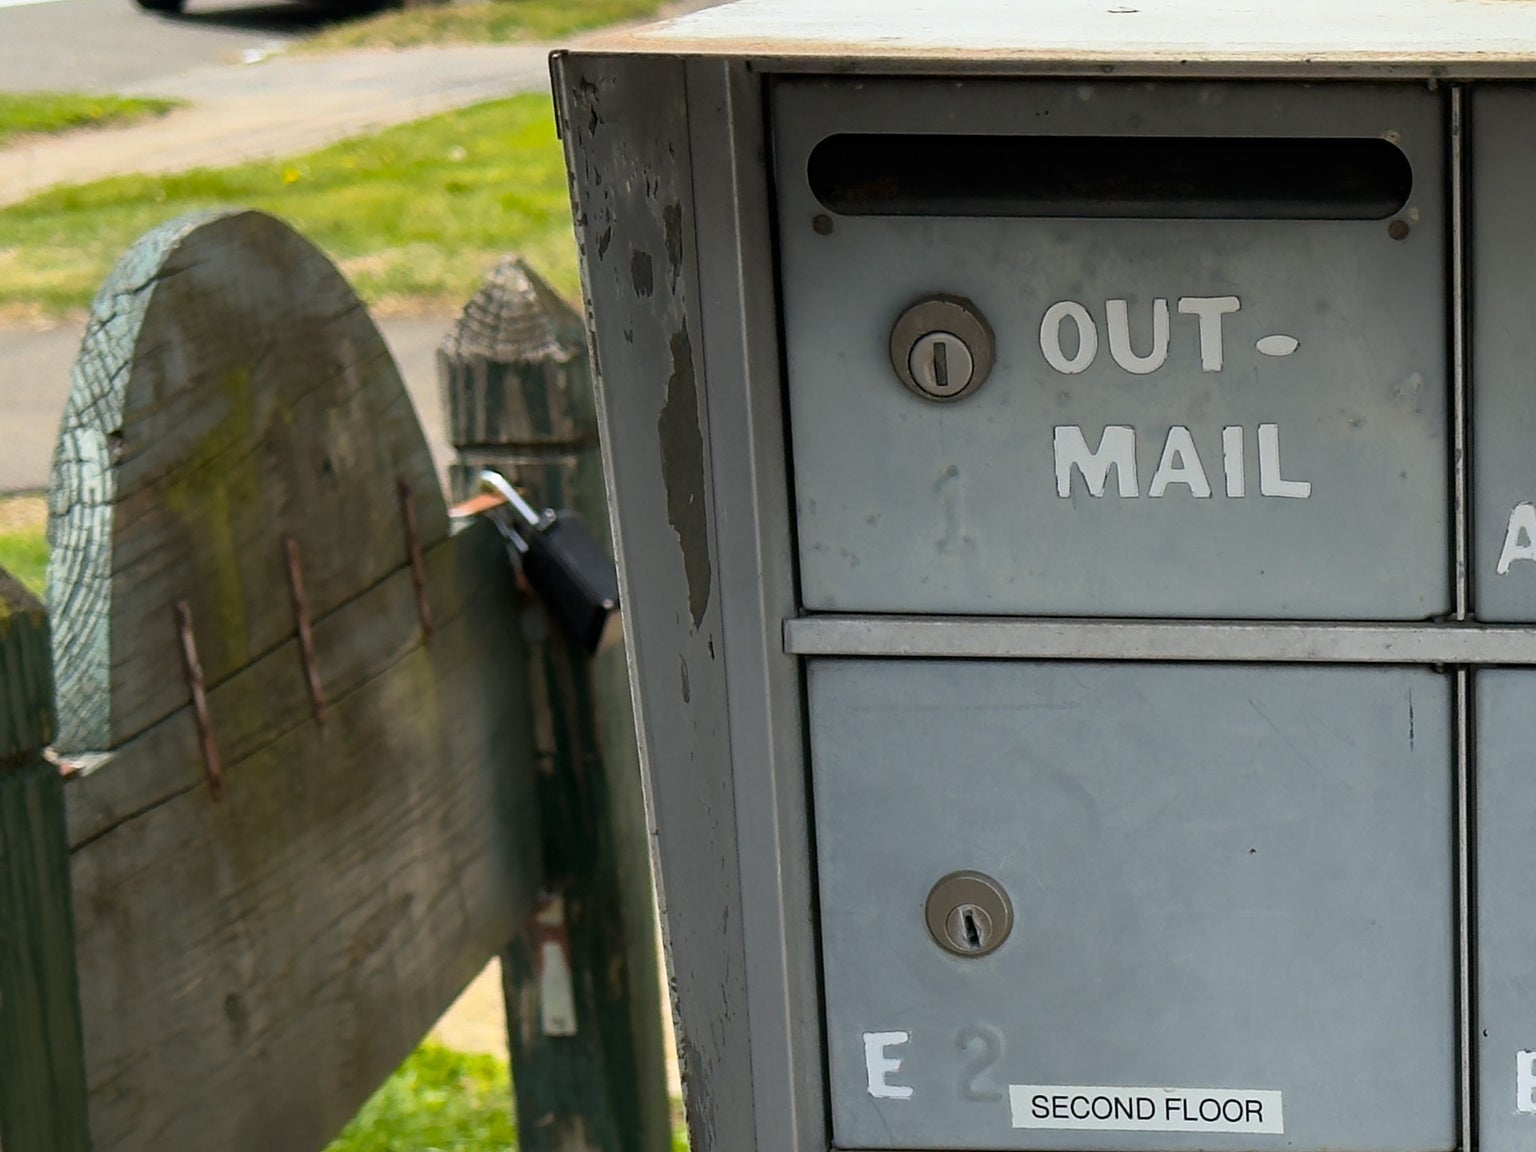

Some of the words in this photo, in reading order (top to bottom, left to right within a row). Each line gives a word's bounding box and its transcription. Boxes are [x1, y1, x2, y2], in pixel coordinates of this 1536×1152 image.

[1039, 296, 1300, 375] OUT-
[1053, 423, 1312, 499] MAIL
[862, 1030, 914, 1100] E
[956, 1025, 1004, 1101] 2
[1030, 1093, 1156, 1122] SECOND
[1164, 1097, 1264, 1124] FLOOR
